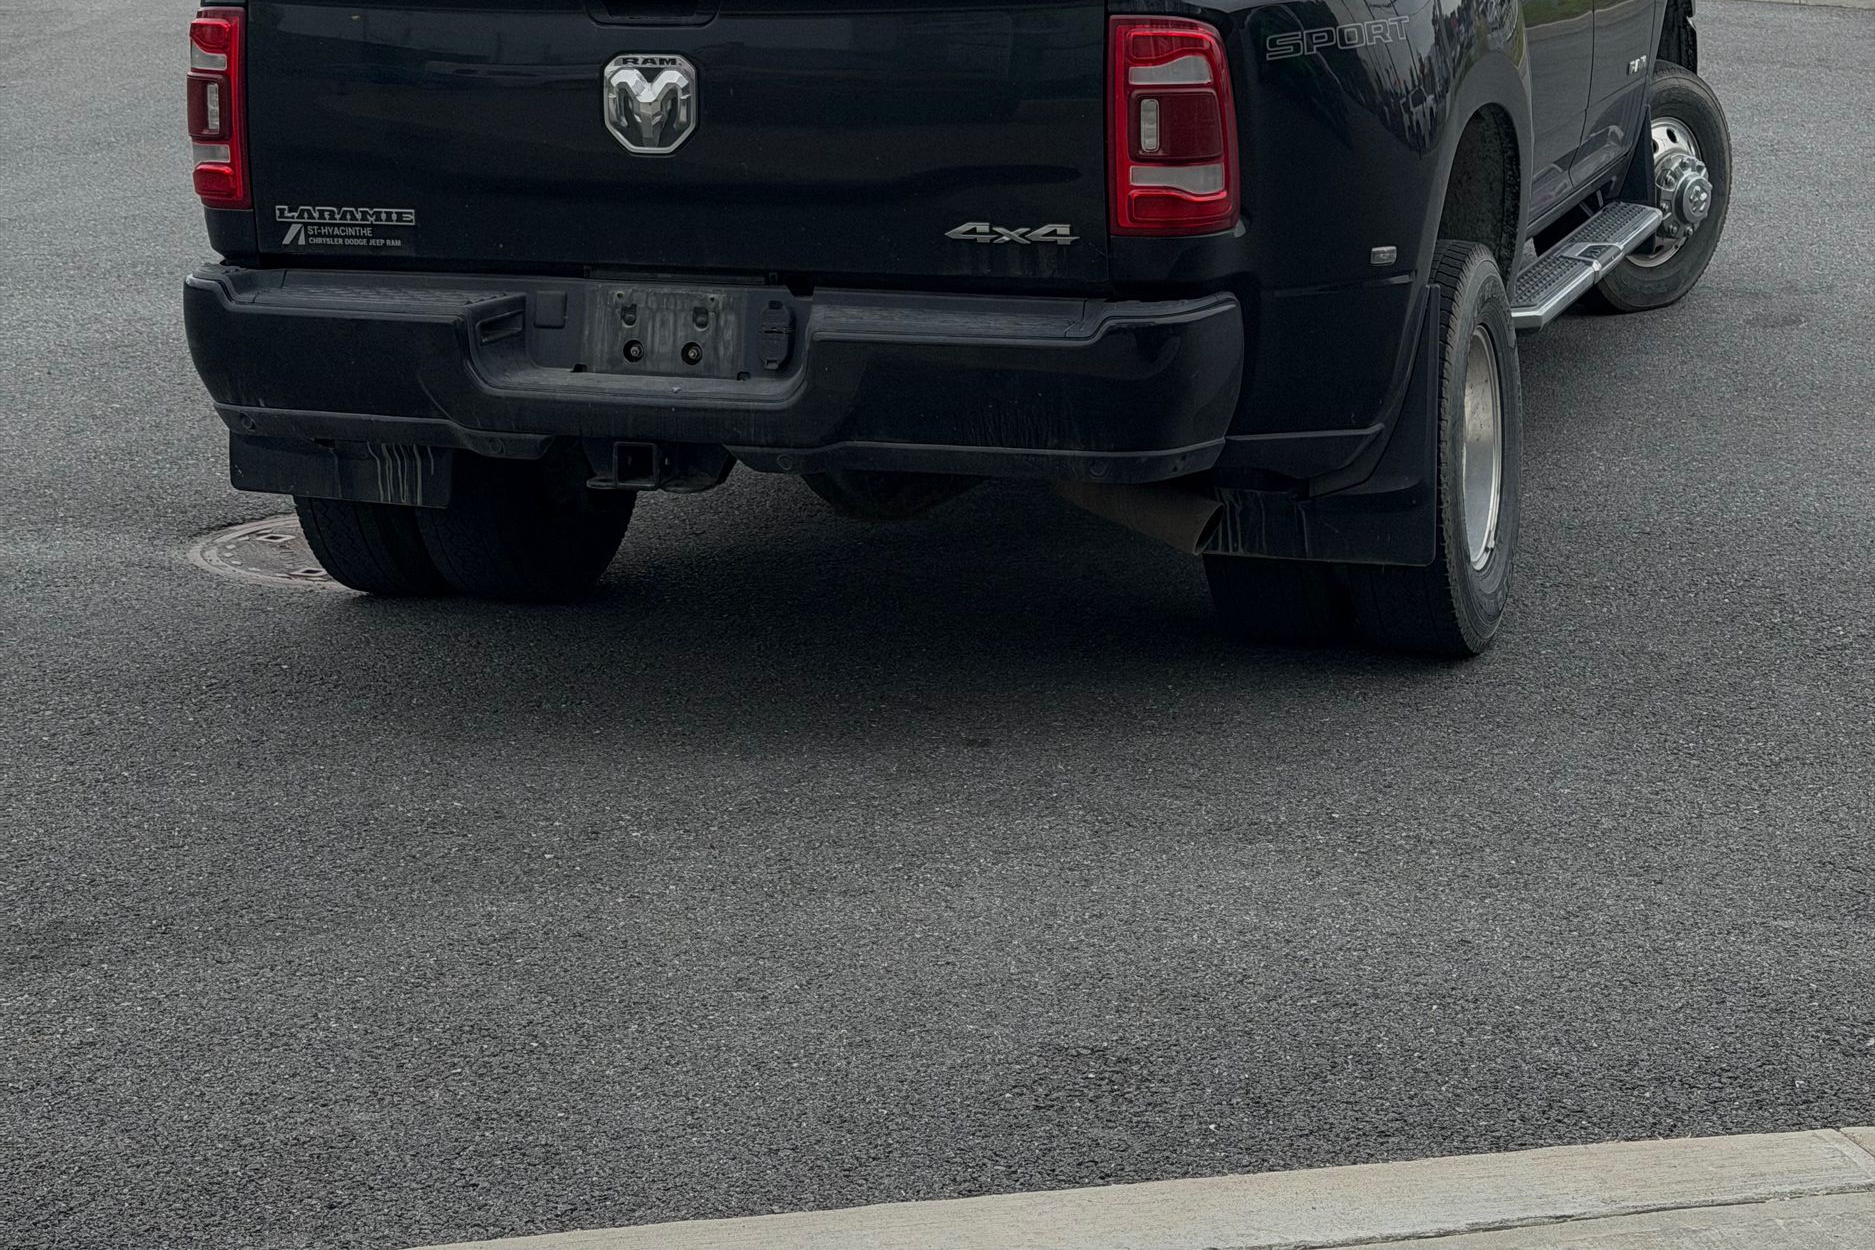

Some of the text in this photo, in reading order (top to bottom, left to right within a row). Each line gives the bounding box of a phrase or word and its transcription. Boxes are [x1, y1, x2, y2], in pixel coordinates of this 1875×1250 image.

[1266, 15, 1410, 61] SPORT
[622, 57, 677, 66] RAM
[275, 205, 416, 225] LARAMIE
[307, 225, 373, 237] ST-HYACINTHE
[308, 236, 402, 247] CHRYSLER DODGE JEEP RAM
